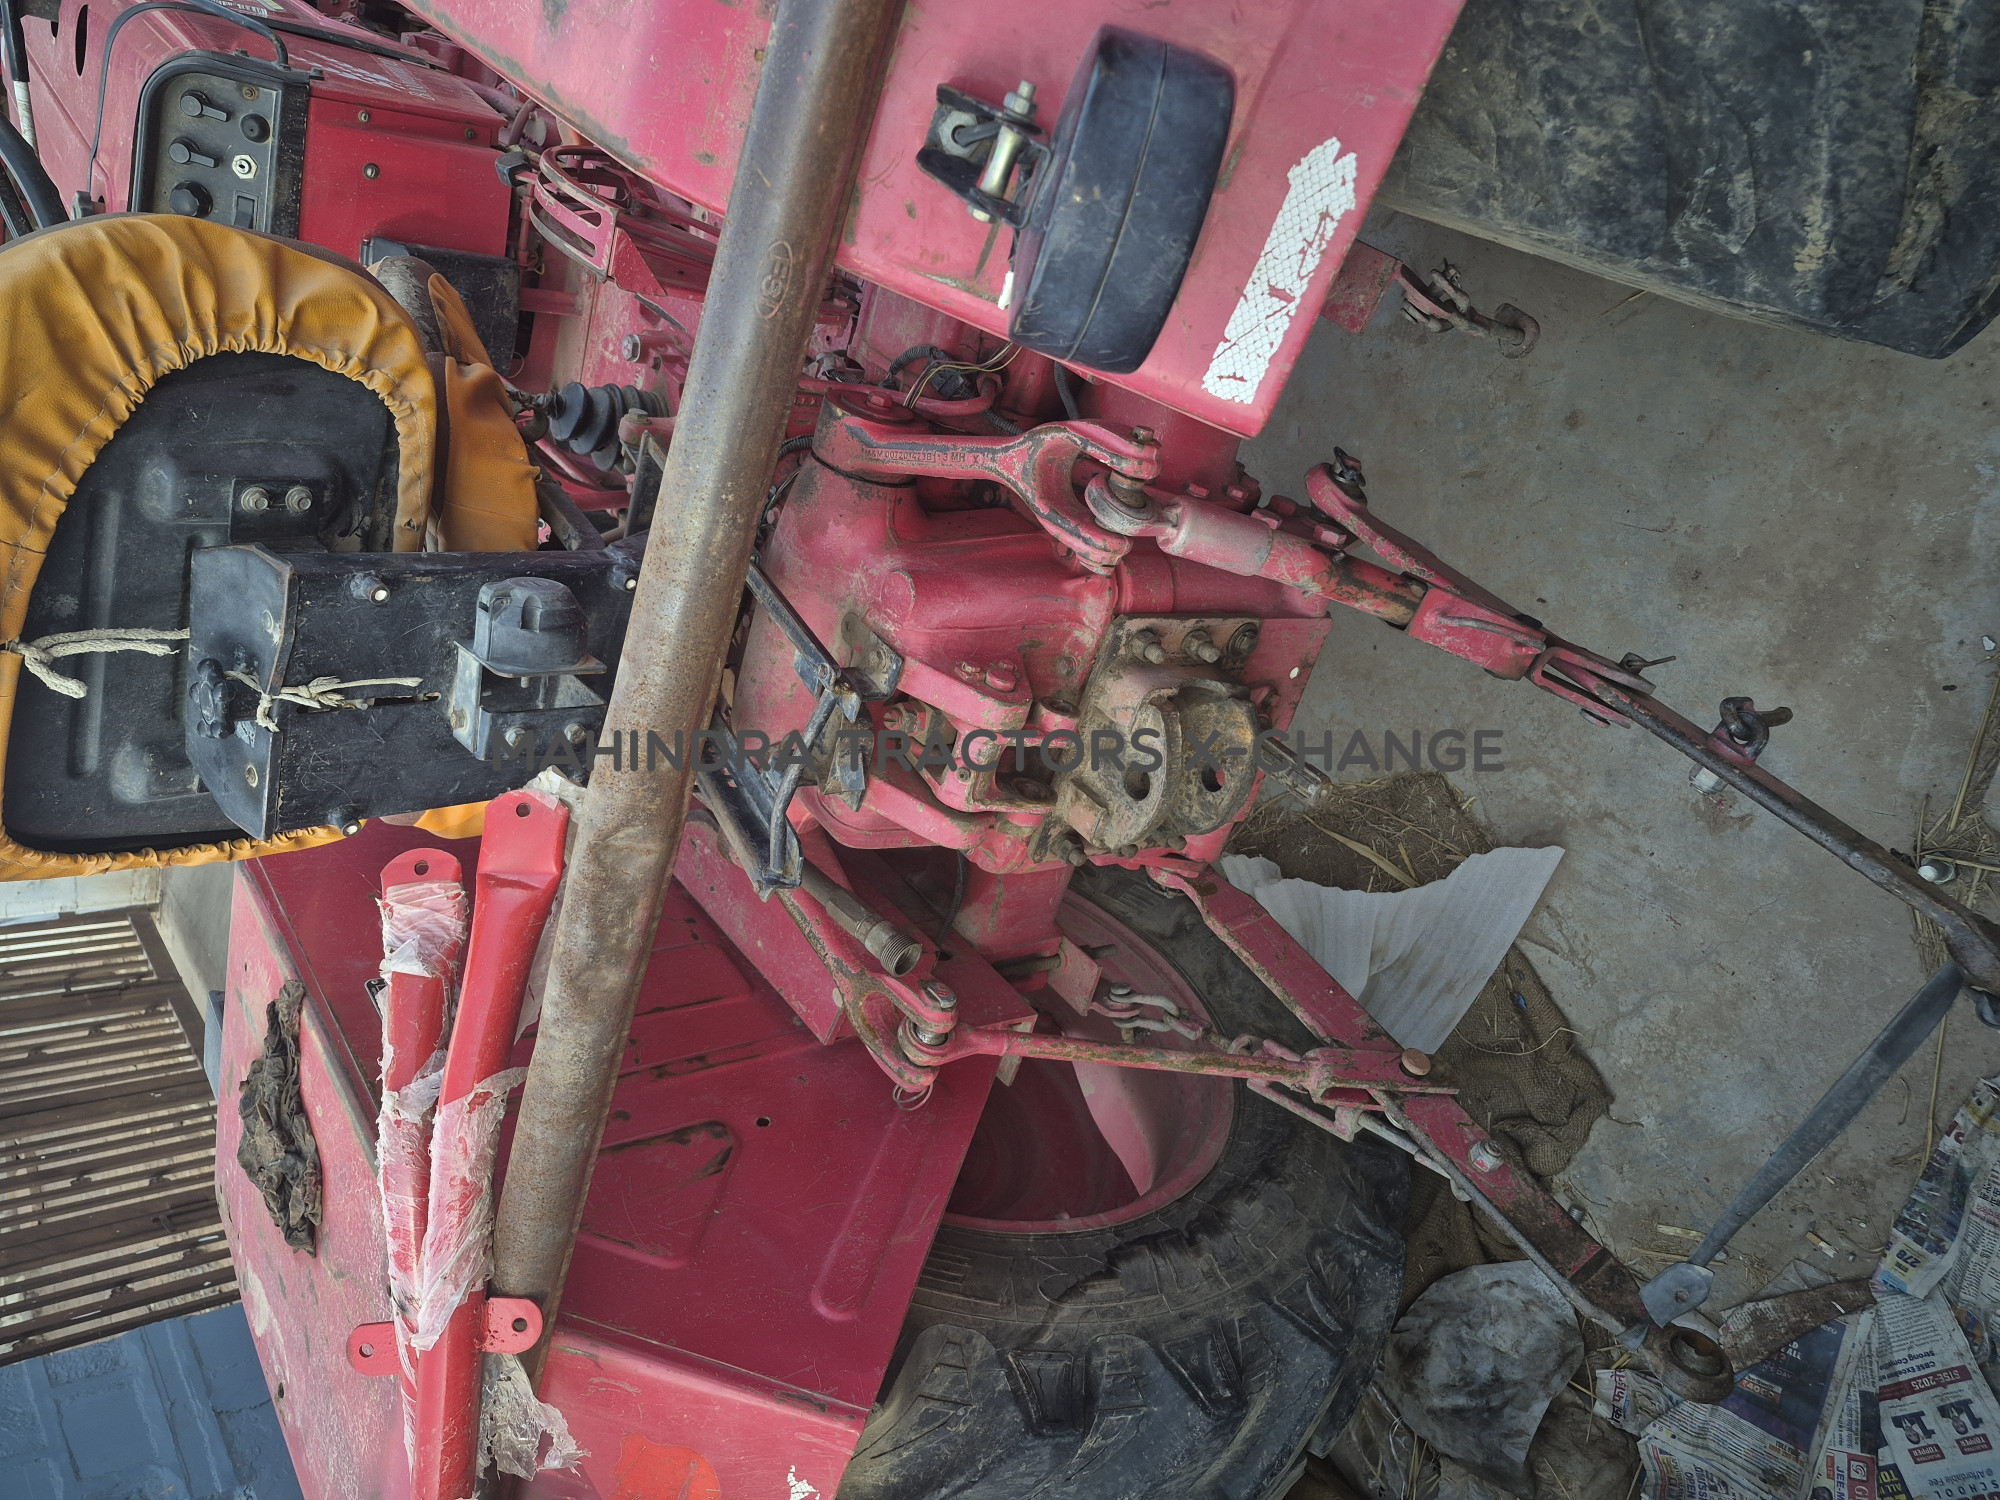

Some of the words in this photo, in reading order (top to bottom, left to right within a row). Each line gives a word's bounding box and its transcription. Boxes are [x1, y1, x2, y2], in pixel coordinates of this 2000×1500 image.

[1896, 1249, 1921, 1269] 278
[1821, 1324, 1837, 1336] ero
[1908, 1352, 1935, 1366] Strong
[1917, 1361, 1936, 1373] CBSE
[1911, 1369, 1960, 1391] STSE-2025
[1960, 1437, 1986, 1448] TOPPER
[1912, 1446, 1938, 1457] TOPPER
[1928, 1478, 1943, 1487] Fee
[1944, 1468, 1994, 1485] @Affordable
[1683, 1471, 1693, 1500] OPEN
[1888, 1483, 1902, 1493] ALL
[1934, 1480, 2000, 1500] SCHOOL
